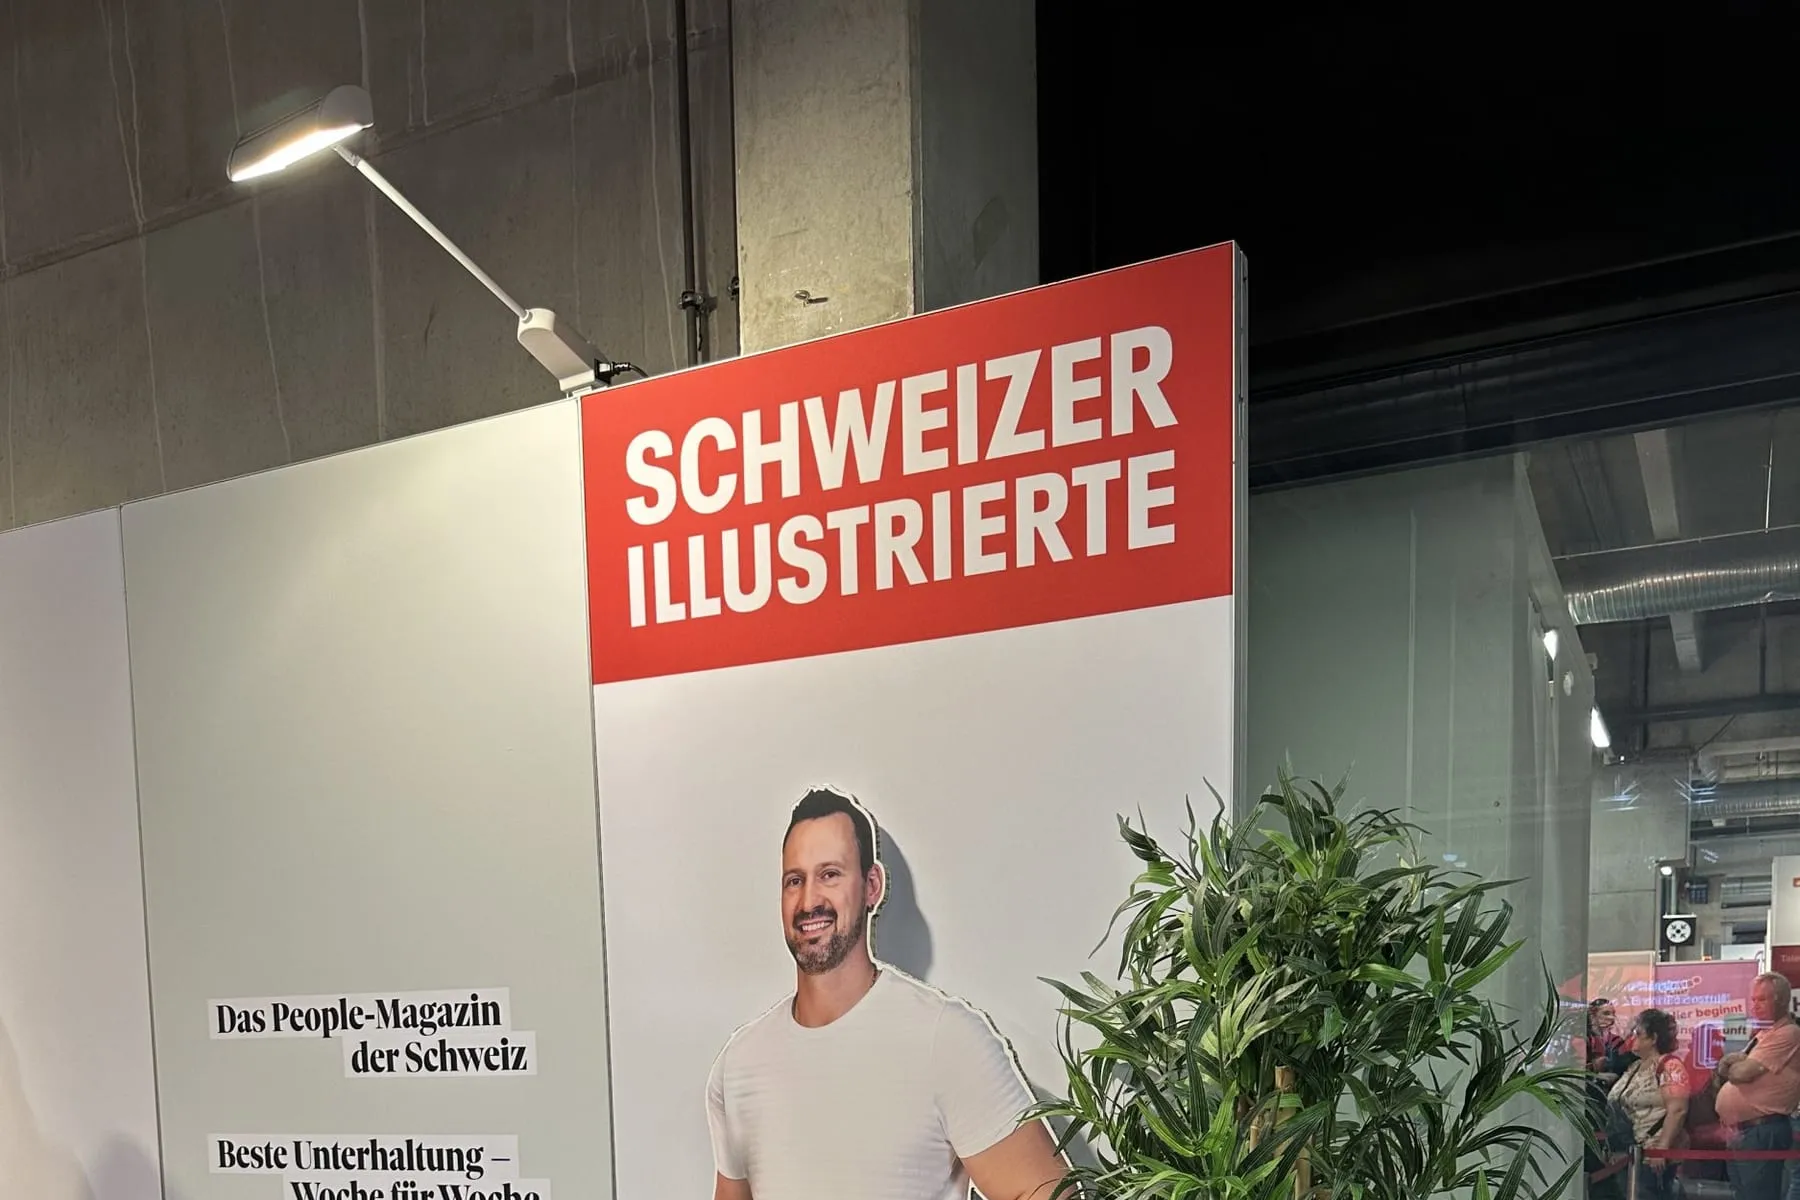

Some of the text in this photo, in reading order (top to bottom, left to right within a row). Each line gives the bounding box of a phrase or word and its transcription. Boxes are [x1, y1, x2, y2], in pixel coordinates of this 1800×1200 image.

[625, 325, 1179, 525] SCHWEIZER
[627, 450, 1176, 628] ILLUSTRIERTE
[216, 993, 502, 1038] Das People-Magazin
[1696, 1003, 1742, 1018] beginnt
[351, 1037, 528, 1074] der Schweiz
[217, 1139, 288, 1169] Beste
[292, 1139, 484, 1180] Unterhaltung
